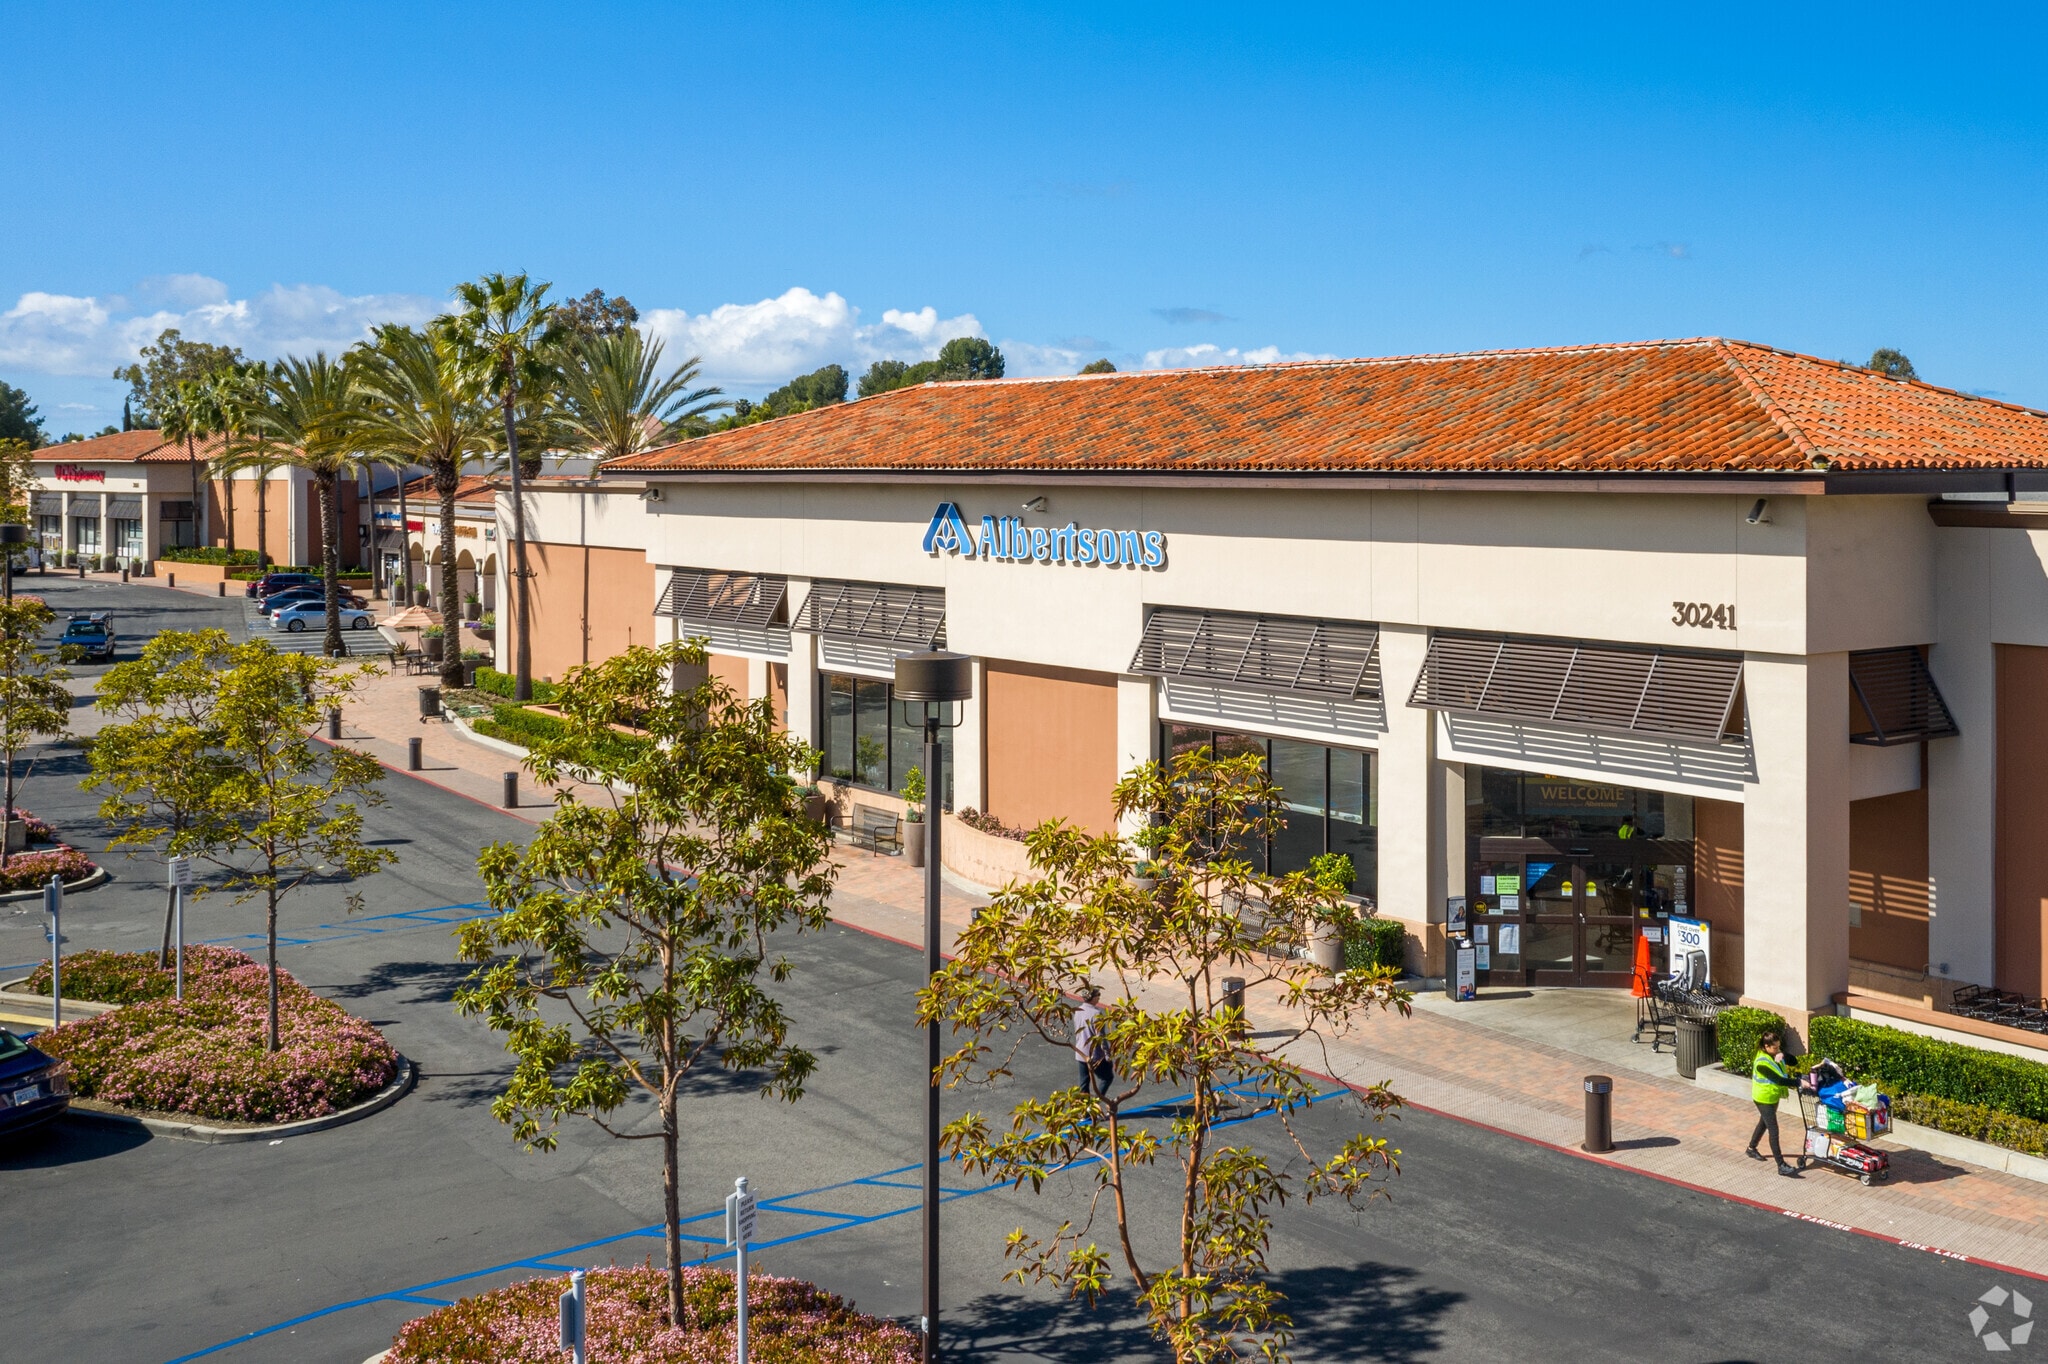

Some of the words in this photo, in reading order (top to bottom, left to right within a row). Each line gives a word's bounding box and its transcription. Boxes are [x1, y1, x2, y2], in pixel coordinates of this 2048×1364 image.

[976, 514, 1167, 567] Albertsons
[1672, 601, 1737, 631] 30241
[1540, 786, 1625, 801] WELCOME
[1678, 931, 1700, 945] $300
[741, 1196, 753, 1207] PLEASE
[740, 1204, 755, 1216] RETURN
[738, 1211, 757, 1226] SHOPPING
[1783, 1210, 1801, 1218] NO
[1801, 1214, 1852, 1231] PARKING
[742, 1221, 753, 1232] CARTS
[1899, 1240, 1930, 1251] FIRE
[1934, 1249, 1969, 1261] LANE
